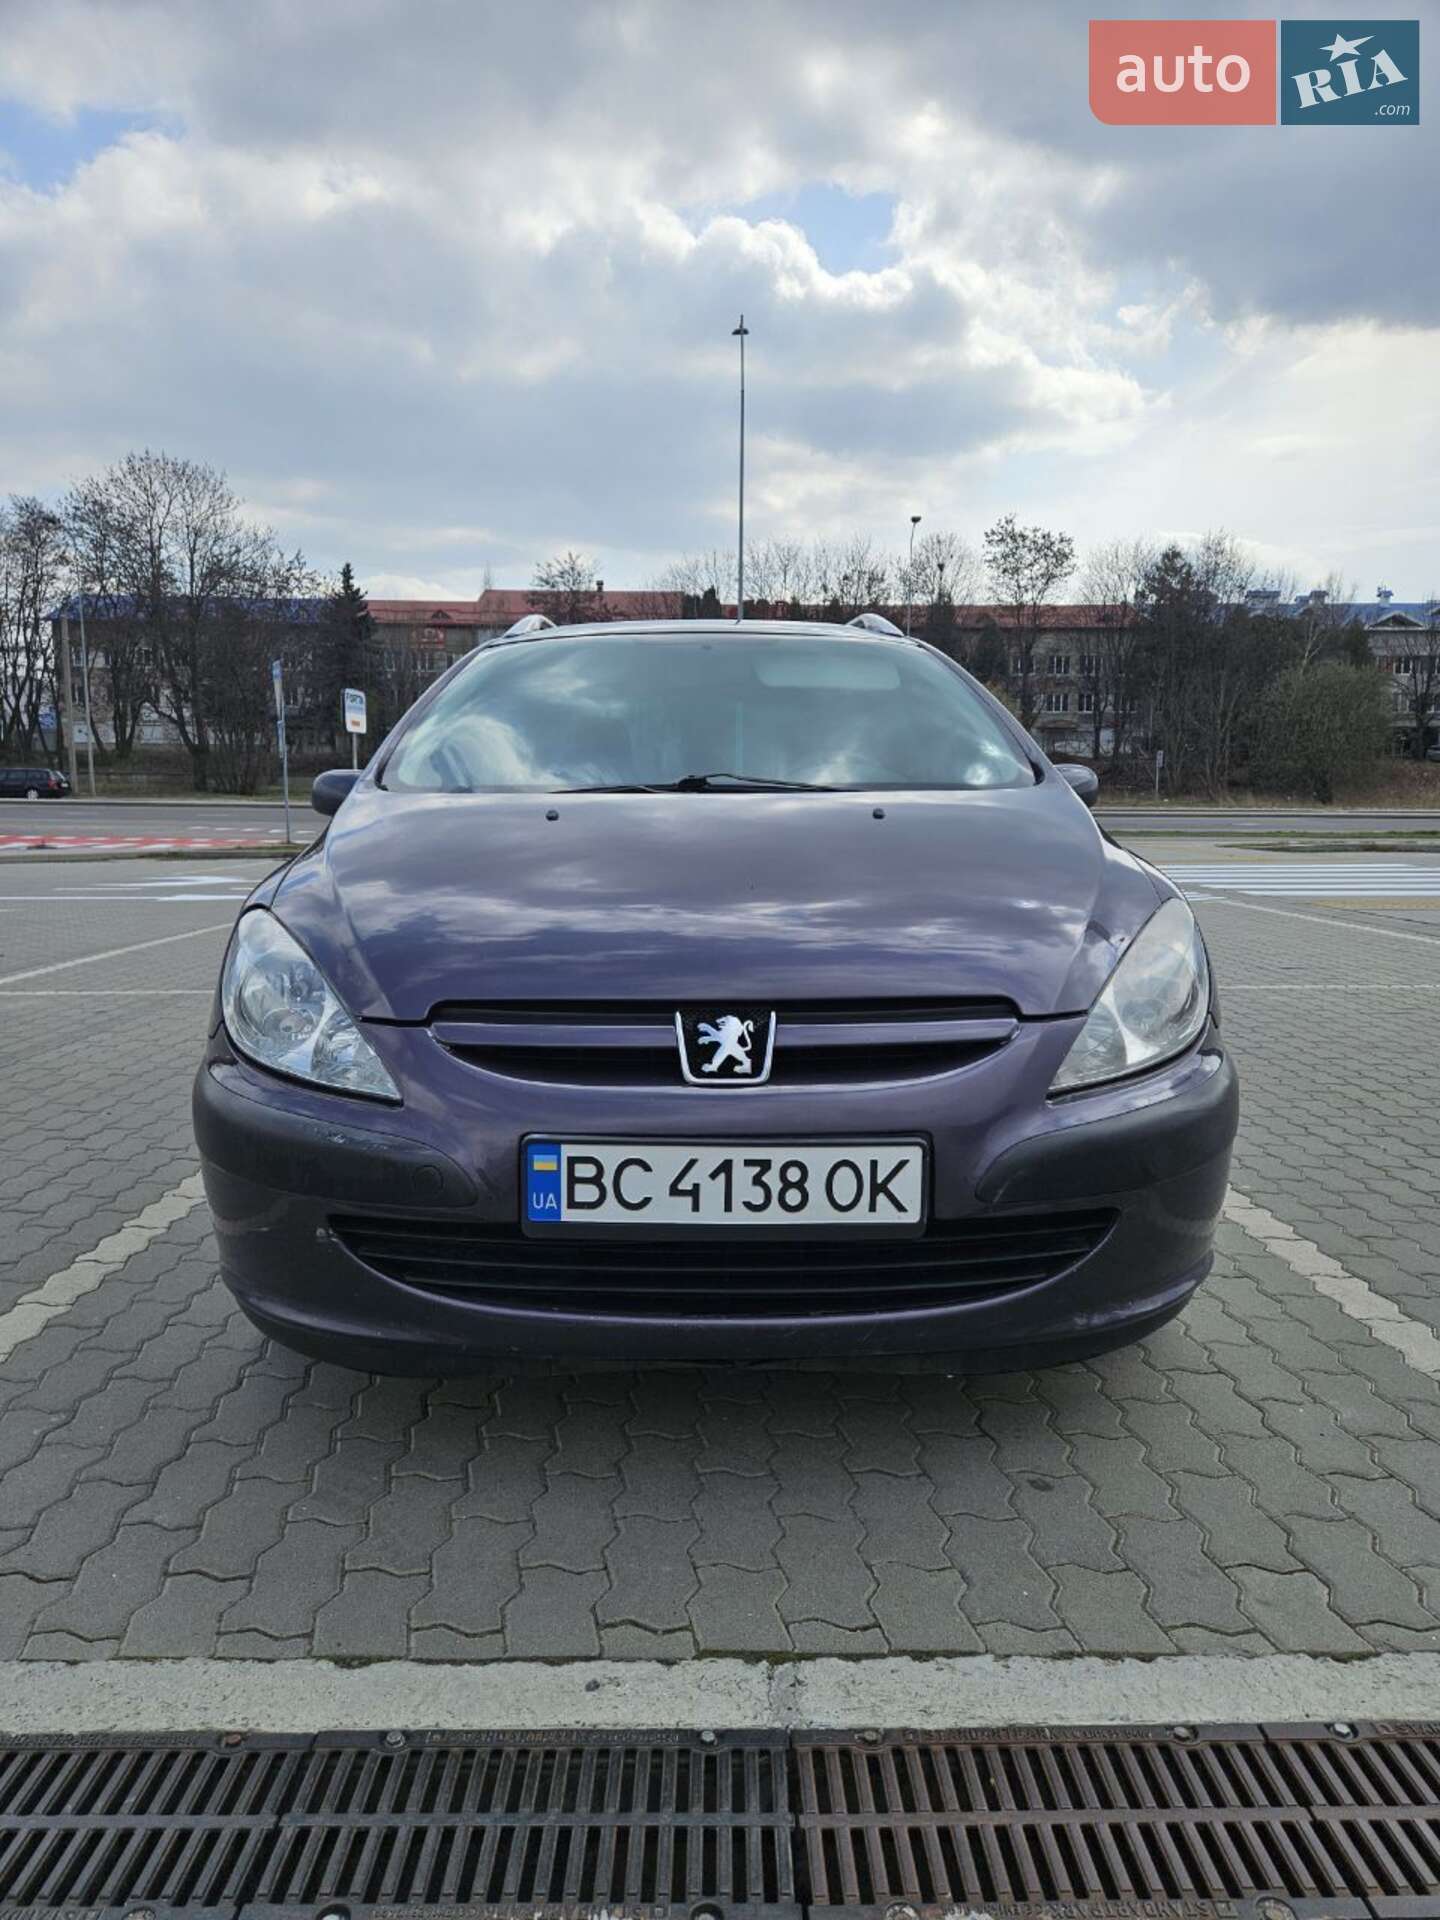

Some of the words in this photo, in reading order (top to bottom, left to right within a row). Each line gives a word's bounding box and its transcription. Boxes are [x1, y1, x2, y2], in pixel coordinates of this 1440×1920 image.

[533, 1192, 558, 1210] UA
[566, 1156, 654, 1212] BC
[668, 1158, 810, 1214] 4138
[825, 1158, 911, 1214] OK
